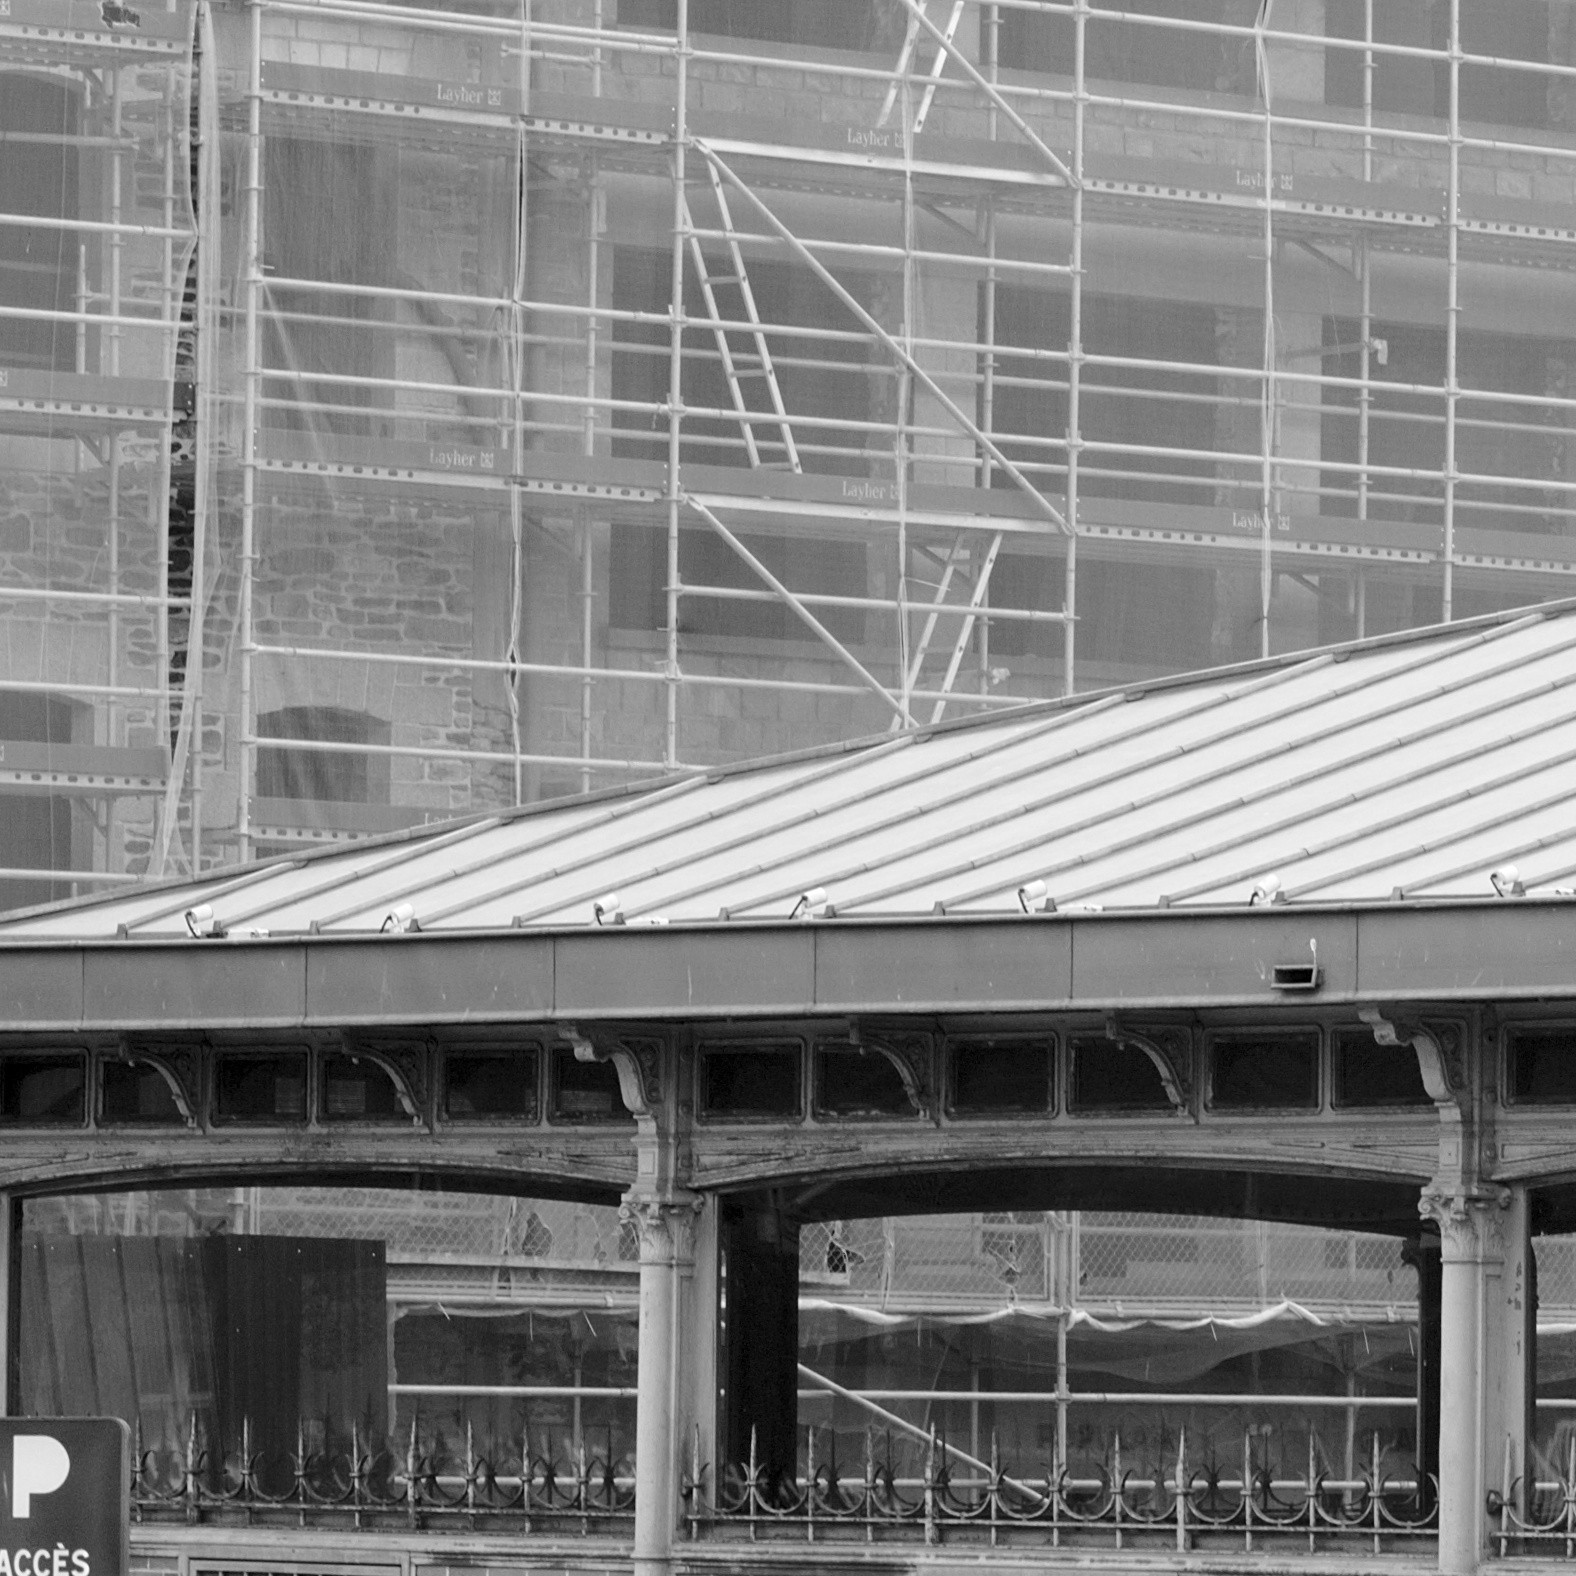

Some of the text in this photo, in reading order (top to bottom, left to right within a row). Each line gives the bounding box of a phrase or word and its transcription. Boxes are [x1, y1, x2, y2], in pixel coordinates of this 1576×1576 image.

[437, 84, 483, 105] Layher
[847, 128, 890, 147] Layher
[429, 448, 476, 468] Layher
[842, 482, 886, 501] Layher
[12, 1435, 71, 1518] P
